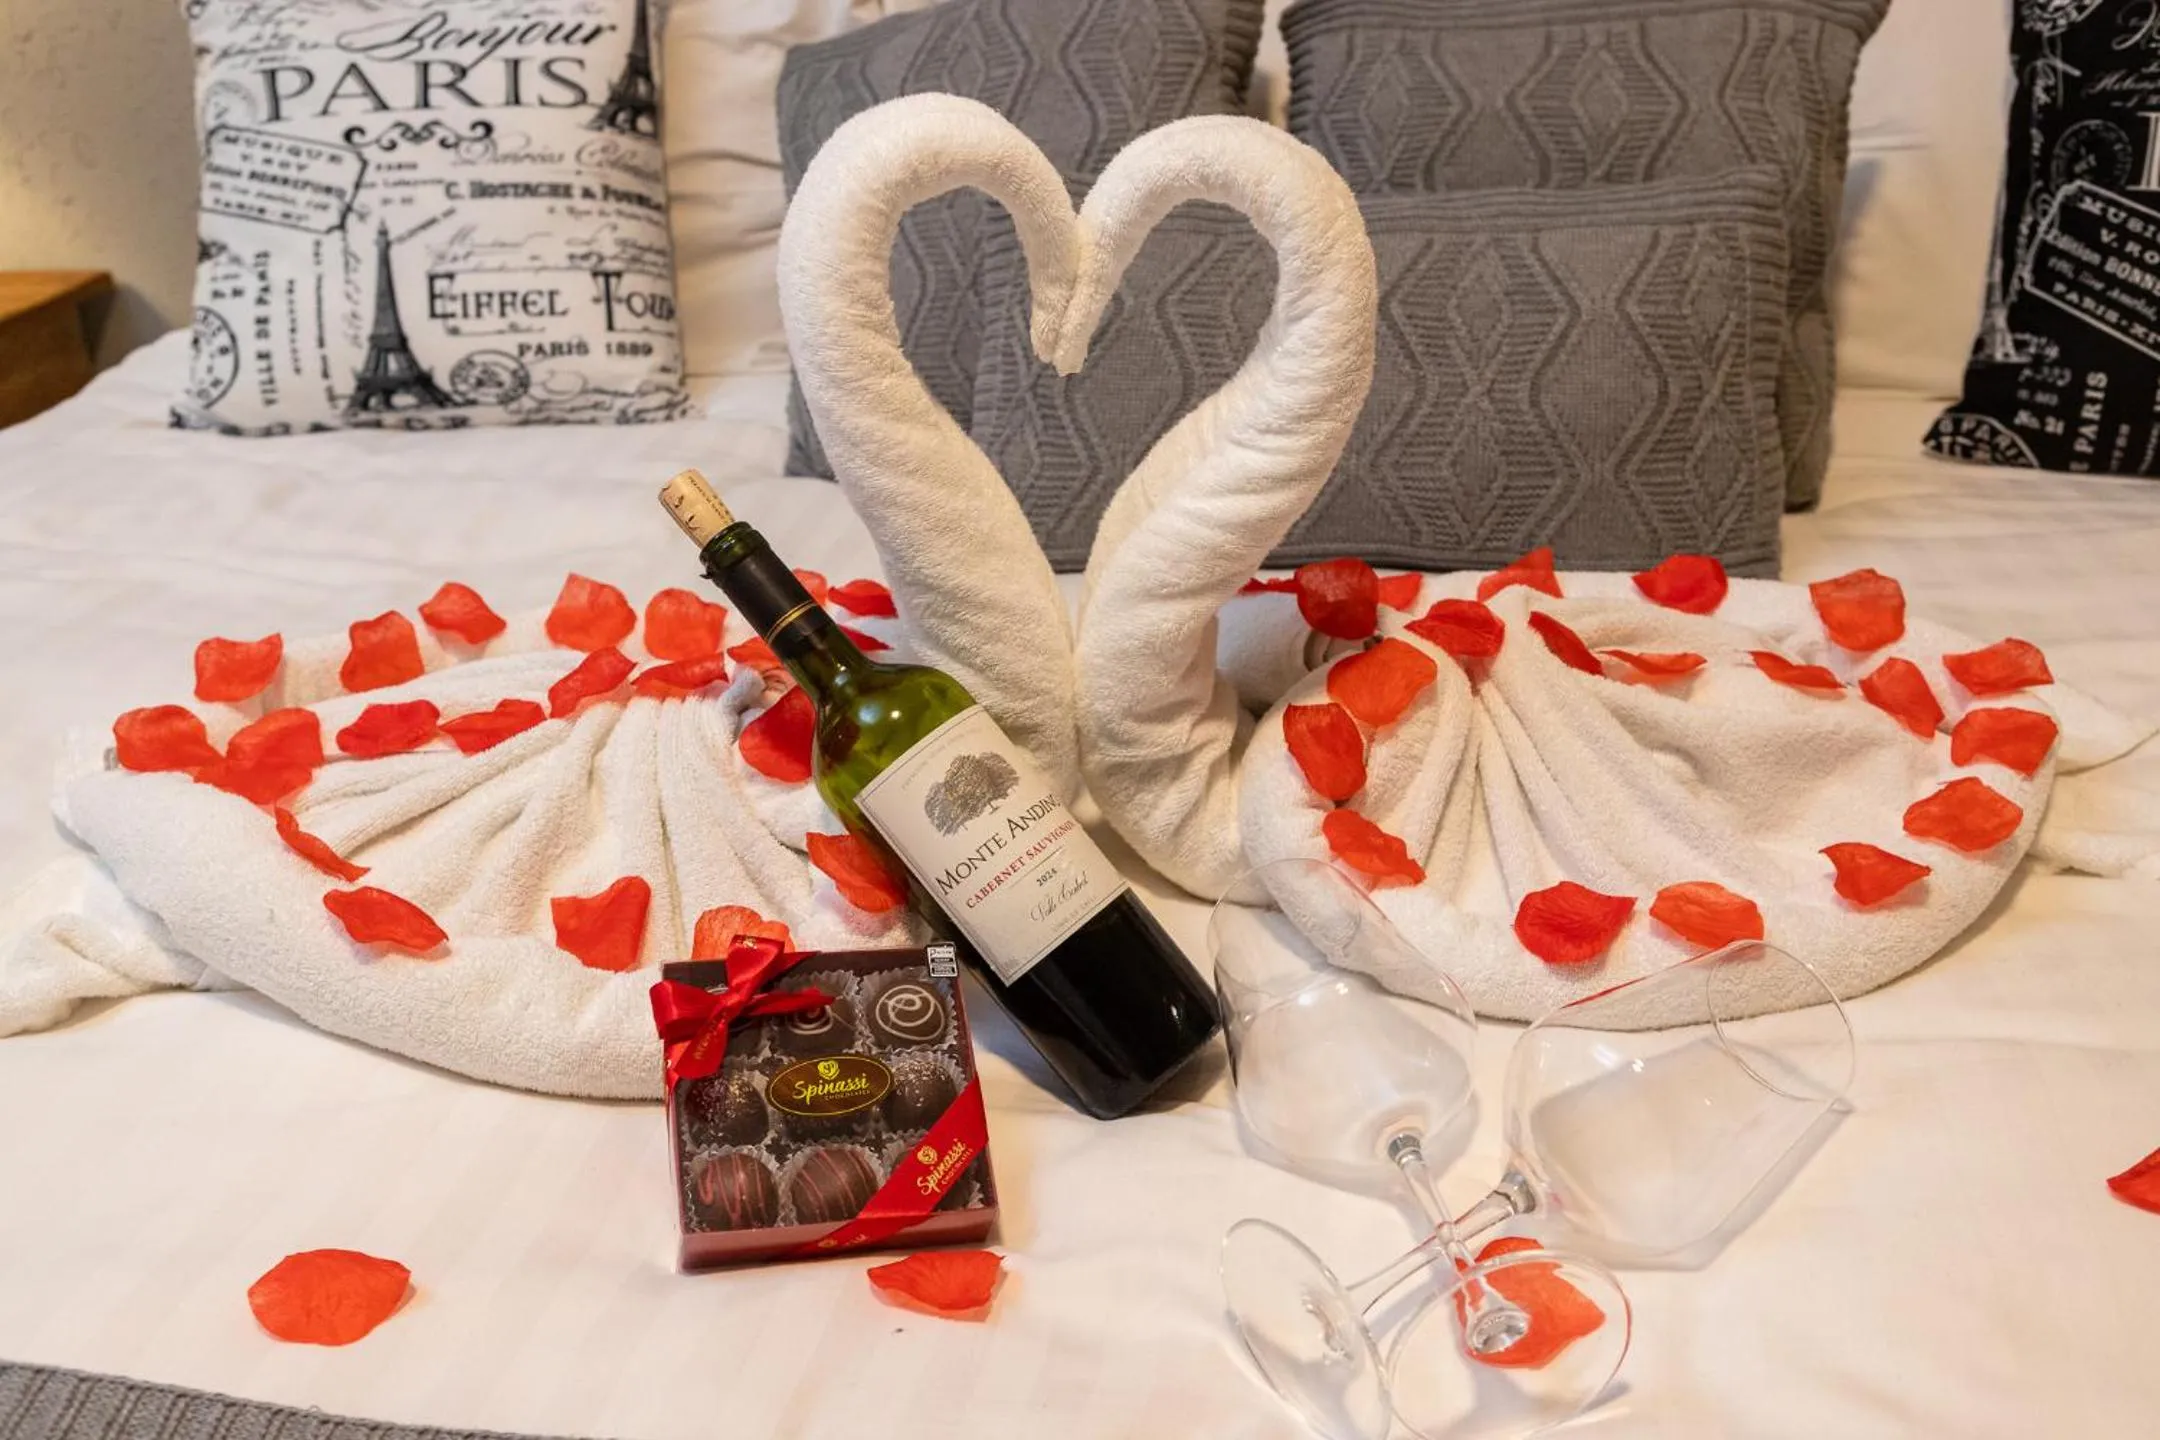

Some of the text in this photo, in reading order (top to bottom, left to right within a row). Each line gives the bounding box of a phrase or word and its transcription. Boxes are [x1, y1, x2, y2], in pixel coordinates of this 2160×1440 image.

[335, 11, 616, 72] Bonjour
[254, 56, 590, 123] PARIS
[2078, 195, 2160, 246] MUSI
[428, 272, 570, 319] EIFFEL
[518, 341, 653, 358] PARIS 1889
[2074, 371, 2108, 455] PARIS
[935, 794, 1061, 895] MONTE ANDIN
[966, 856, 1026, 909] CABERNET
[792, 1072, 870, 1105] Spinassi
[916, 1138, 966, 1196] Spinassi
